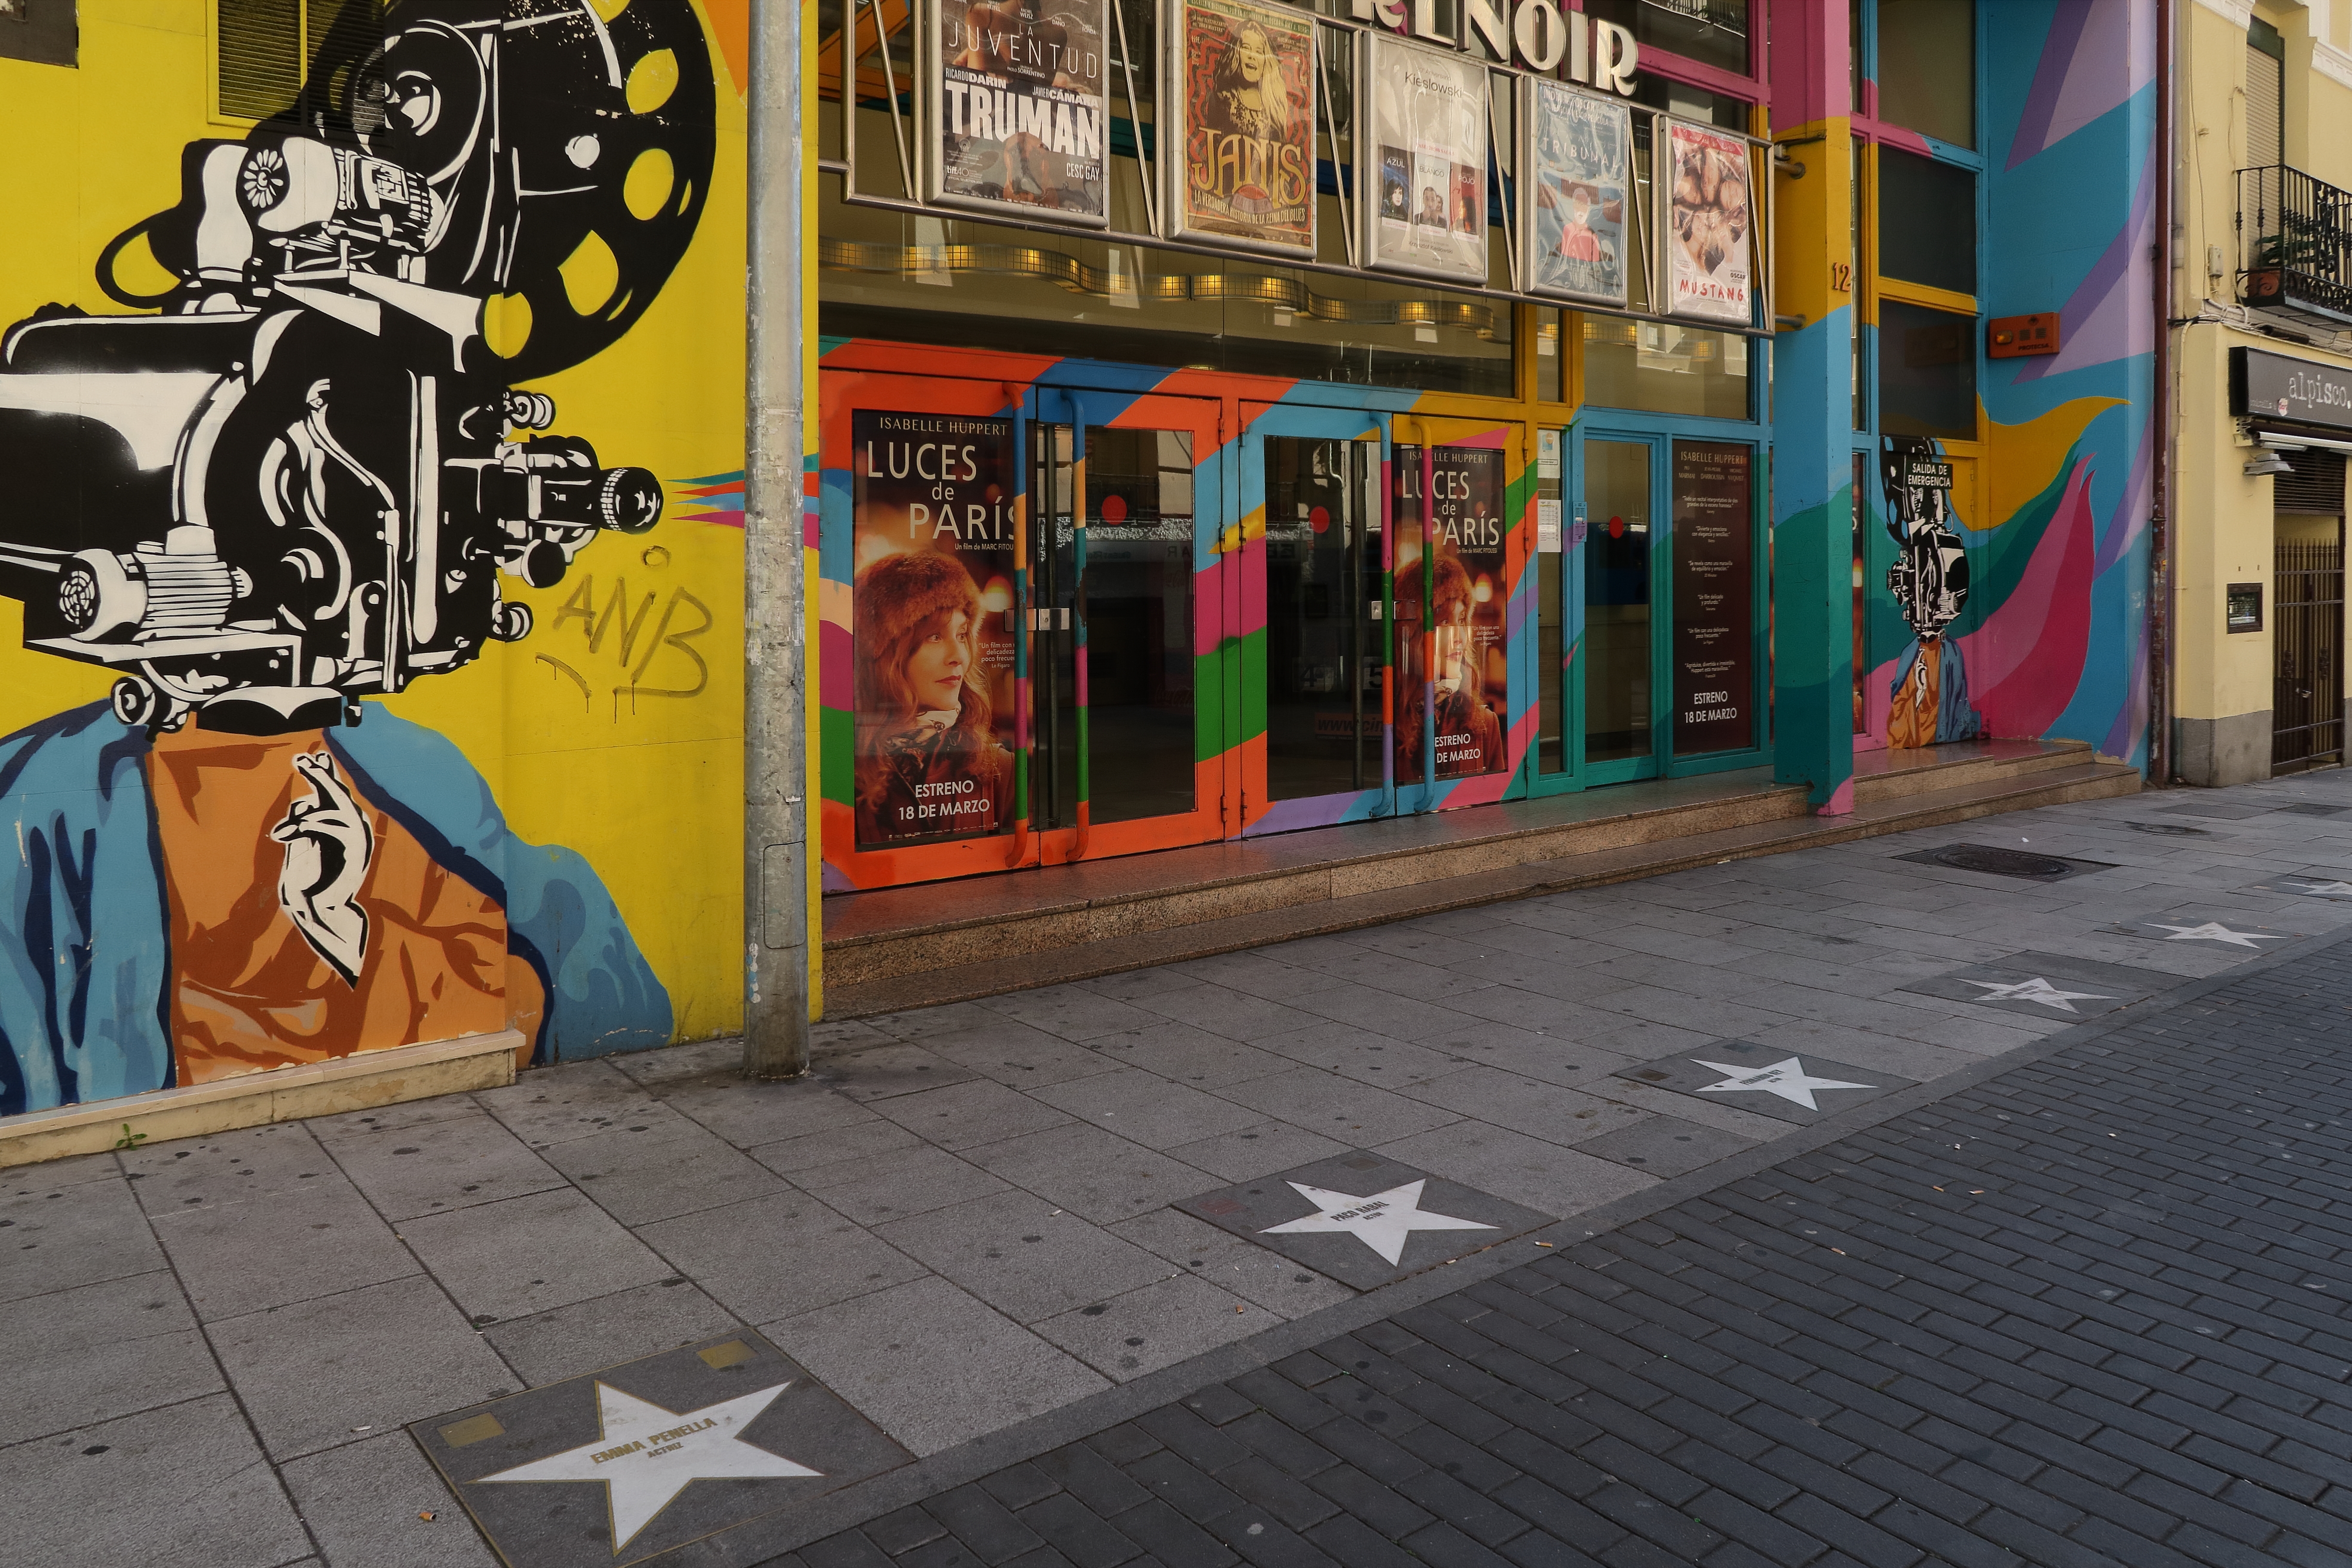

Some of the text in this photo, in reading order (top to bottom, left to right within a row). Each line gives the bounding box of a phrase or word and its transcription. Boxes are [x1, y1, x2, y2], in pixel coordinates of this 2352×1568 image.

[1019, 24, 1033, 37] LA
[949, 21, 1097, 79] JUVENTUD
[1017, 67, 1045, 79] SORRENTINO
[1032, 86, 1099, 107] JAVIER CÁMARA
[946, 80, 1099, 159] TRUMAN
[1066, 162, 1099, 181] CESC GAY
[1192, 127, 1306, 209] JANIS
[1387, 157, 1406, 168] AZUL
[1419, 165, 1445, 178] BLANCO
[1195, 190, 1201, 204] LA
[1202, 192, 1229, 215] VERDADERA
[1230, 207, 1251, 223] HISTORIA
[1252, 214, 1258, 224] DE
[1259, 214, 1265, 224] LA
[1266, 212, 1280, 223] REINA
[1281, 210, 1289, 221] DEL
[1290, 208, 1305, 221] BLUES
[1833, 262, 1852, 292] 12
[1679, 279, 1744, 302] MUSTANG
[880, 417, 1008, 436] ISABELLE HUPPERT
[868, 441, 977, 481] LUCES
[1452, 454, 1488, 464] HUPPERT
[1681, 451, 1743, 464] ISABELLE HUPPERT
[1912, 463, 1947, 475] SALIDA DE
[1908, 475, 1951, 487] EMERGENCIA
[931, 481, 954, 500] de
[1442, 500, 1456, 515] de
[1694, 691, 1728, 704] ESTRENO
[1685, 707, 1737, 723] 18 DE MARZO
[1435, 733, 1470, 747] ESTRENO
[1437, 748, 1480, 763] DE MARZO
[915, 780, 974, 798] ESTRENO
[899, 799, 990, 821] 18 DE MARZO
[1330, 1201, 1390, 1222] PACO RABAL
[590, 1418, 718, 1464] EMMA PENELLA
[647, 1442, 684, 1458] ACTRIZ
